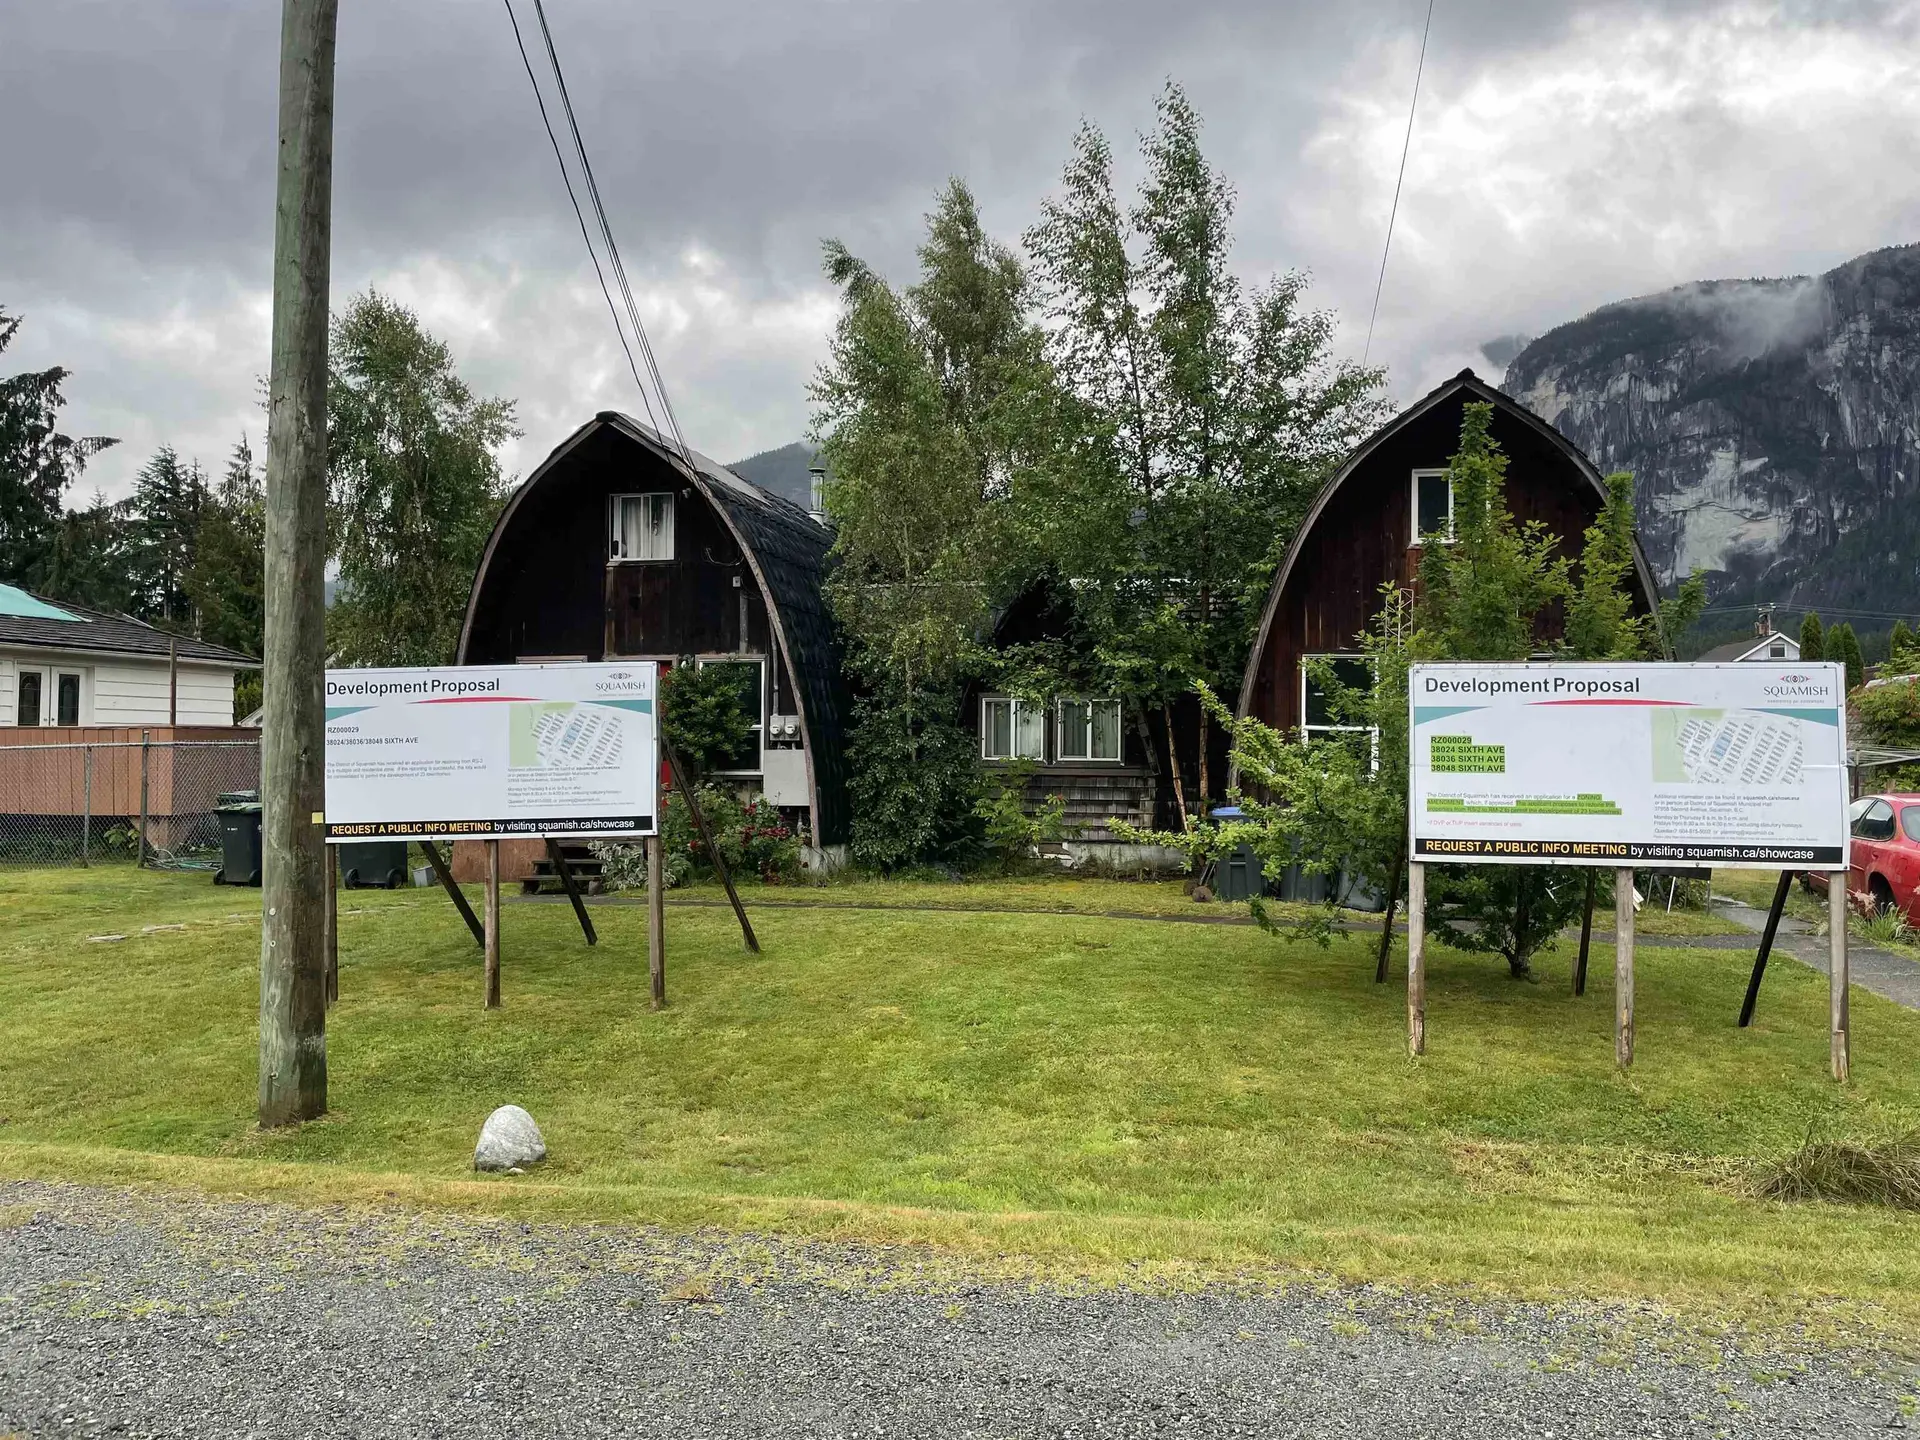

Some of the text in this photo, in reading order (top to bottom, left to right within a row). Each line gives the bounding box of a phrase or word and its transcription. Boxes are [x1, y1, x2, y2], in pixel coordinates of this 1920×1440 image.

[327, 678, 500, 697] Development Proposal
[595, 682, 646, 692] SQUAMISH
[1425, 677, 1640, 696] Development Proposal
[1763, 686, 1829, 697] SQUAMISH
[1431, 736, 1472, 744] RZ000029
[1431, 745, 1505, 753] 38024 SIXTH AVE
[1431, 754, 1505, 762] 38036 SIXTH AVE
[1431, 764, 1505, 772] 38048 SIXTH AVE
[331, 818, 634, 835] REQUEST A PUBLIC INFO MEETING by visiting squamish.ca/showcase
[1426, 840, 1814, 860] REQUEST A PUBLIC INFO MEETING by visiting squamish.ca/showcase
